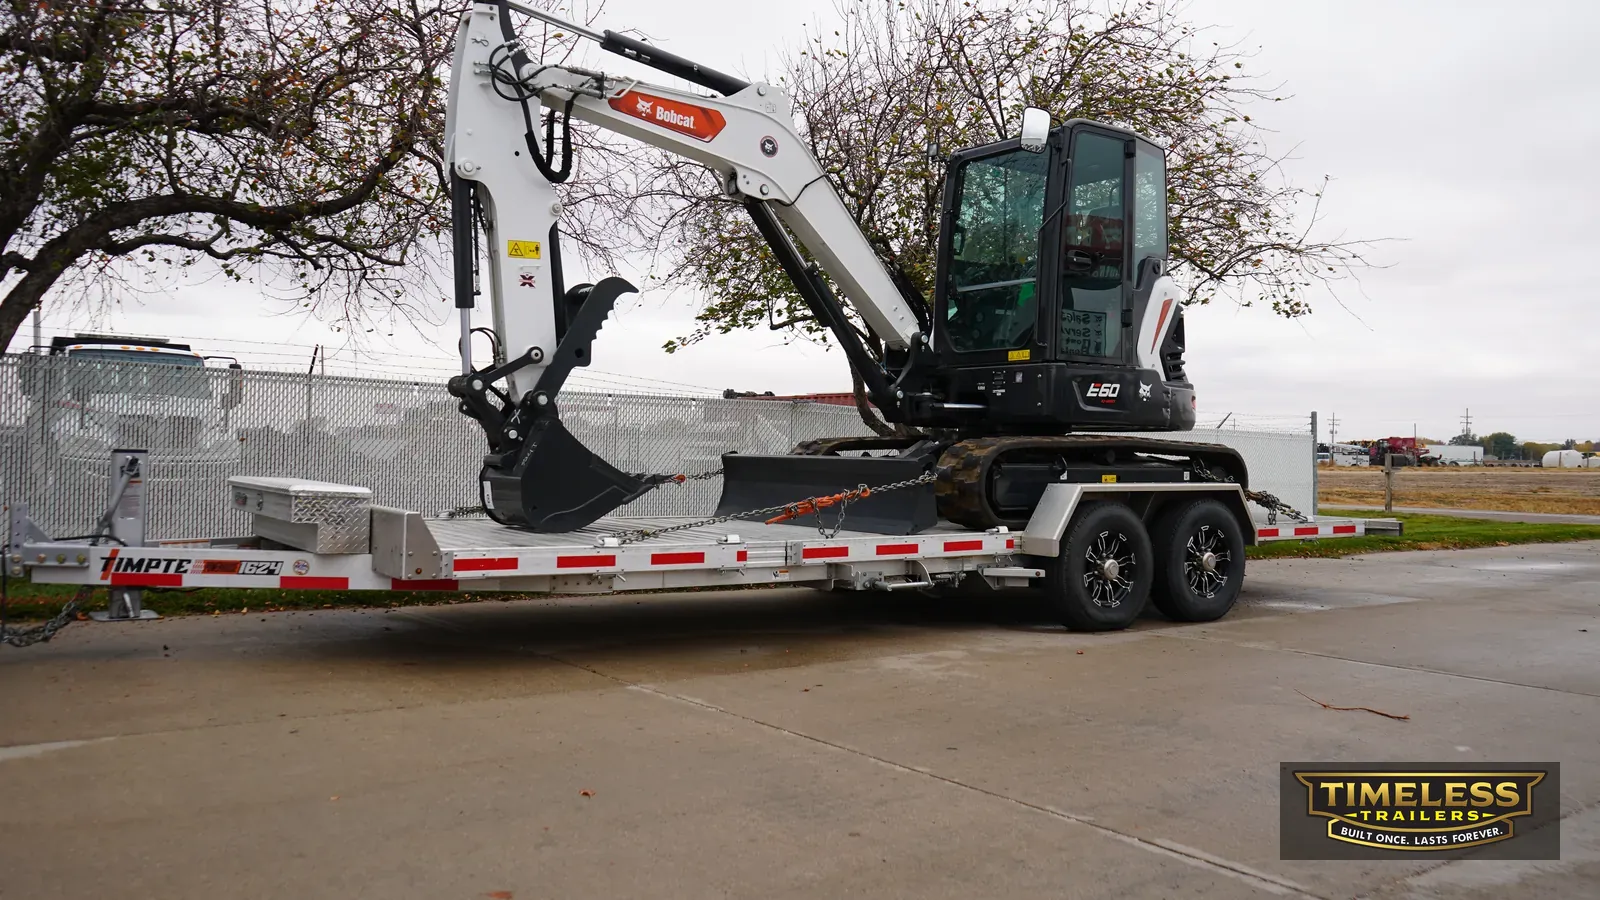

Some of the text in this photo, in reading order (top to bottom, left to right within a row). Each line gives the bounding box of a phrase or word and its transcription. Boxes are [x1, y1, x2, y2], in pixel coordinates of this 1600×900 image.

[656, 105, 695, 128] Bobcat
[1086, 383, 1120, 397] E60
[100, 554, 191, 575] TIMPTE
[239, 561, 282, 575] 1624
